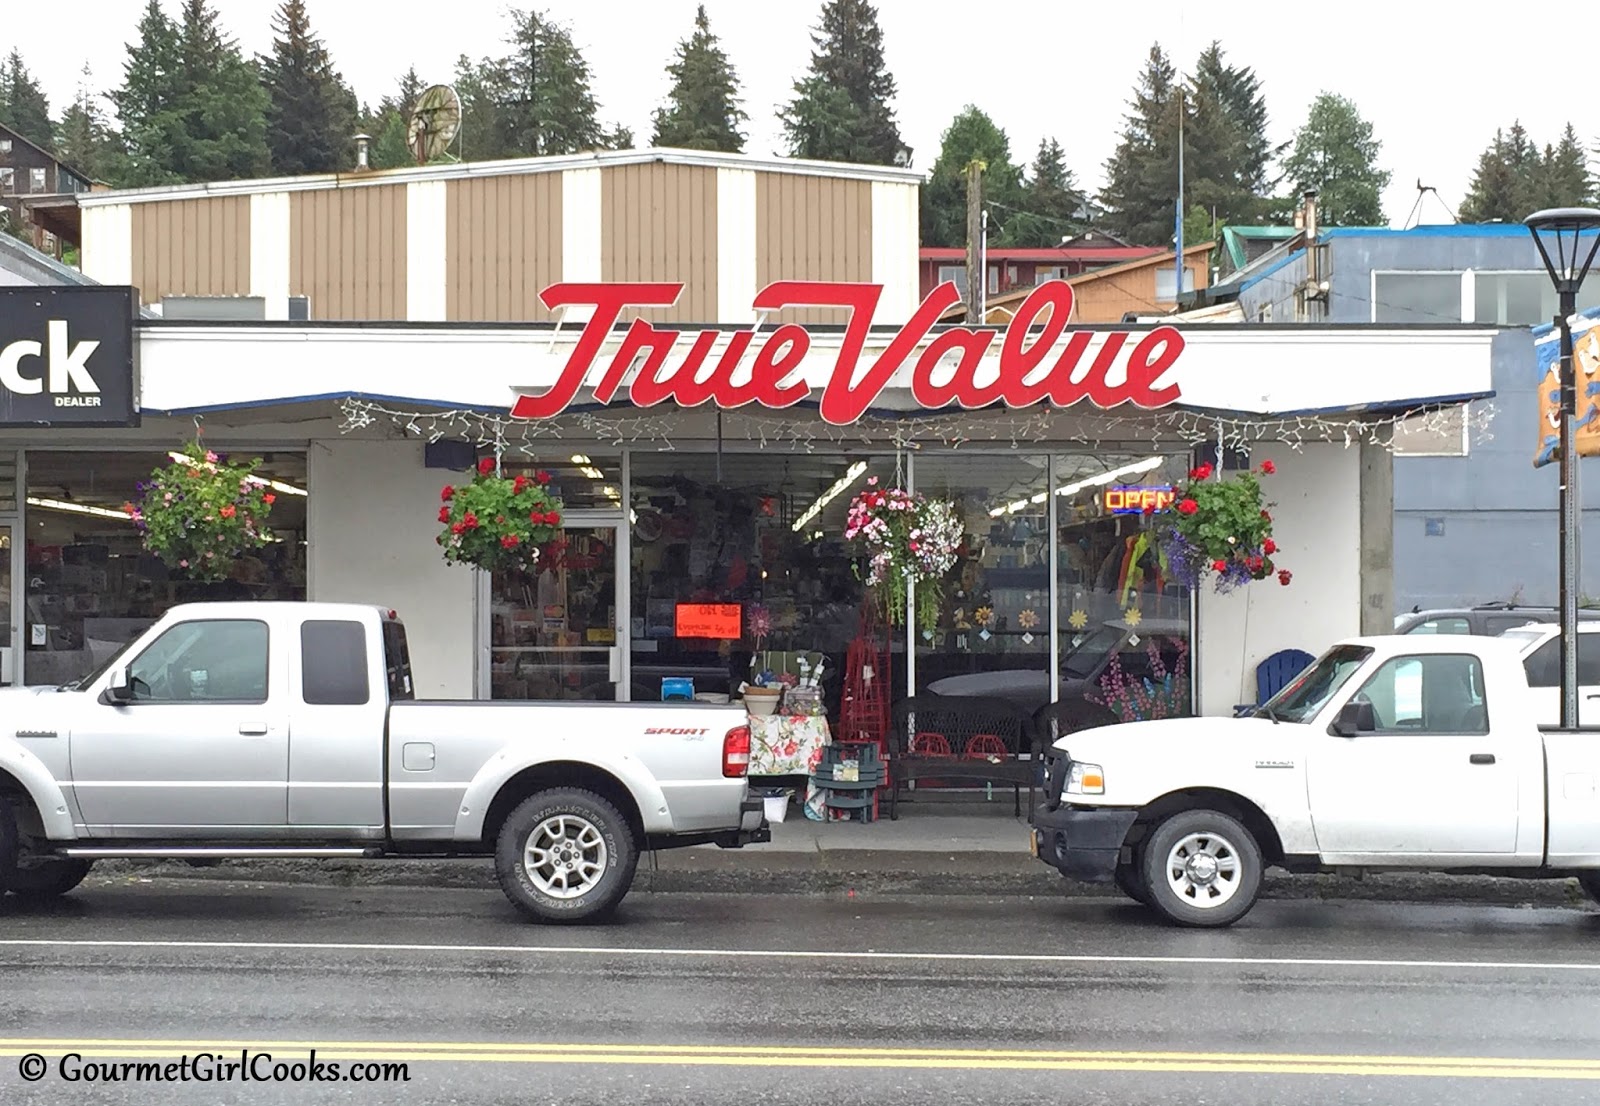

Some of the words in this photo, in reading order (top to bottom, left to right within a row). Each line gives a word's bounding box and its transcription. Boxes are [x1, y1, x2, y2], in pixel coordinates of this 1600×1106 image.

[510, 281, 811, 420] True
[753, 278, 1182, 426] Value
[54, 397, 101, 407] DEALER
[1105, 490, 1176, 509] OPEN
[644, 727, 710, 735] SPORT
